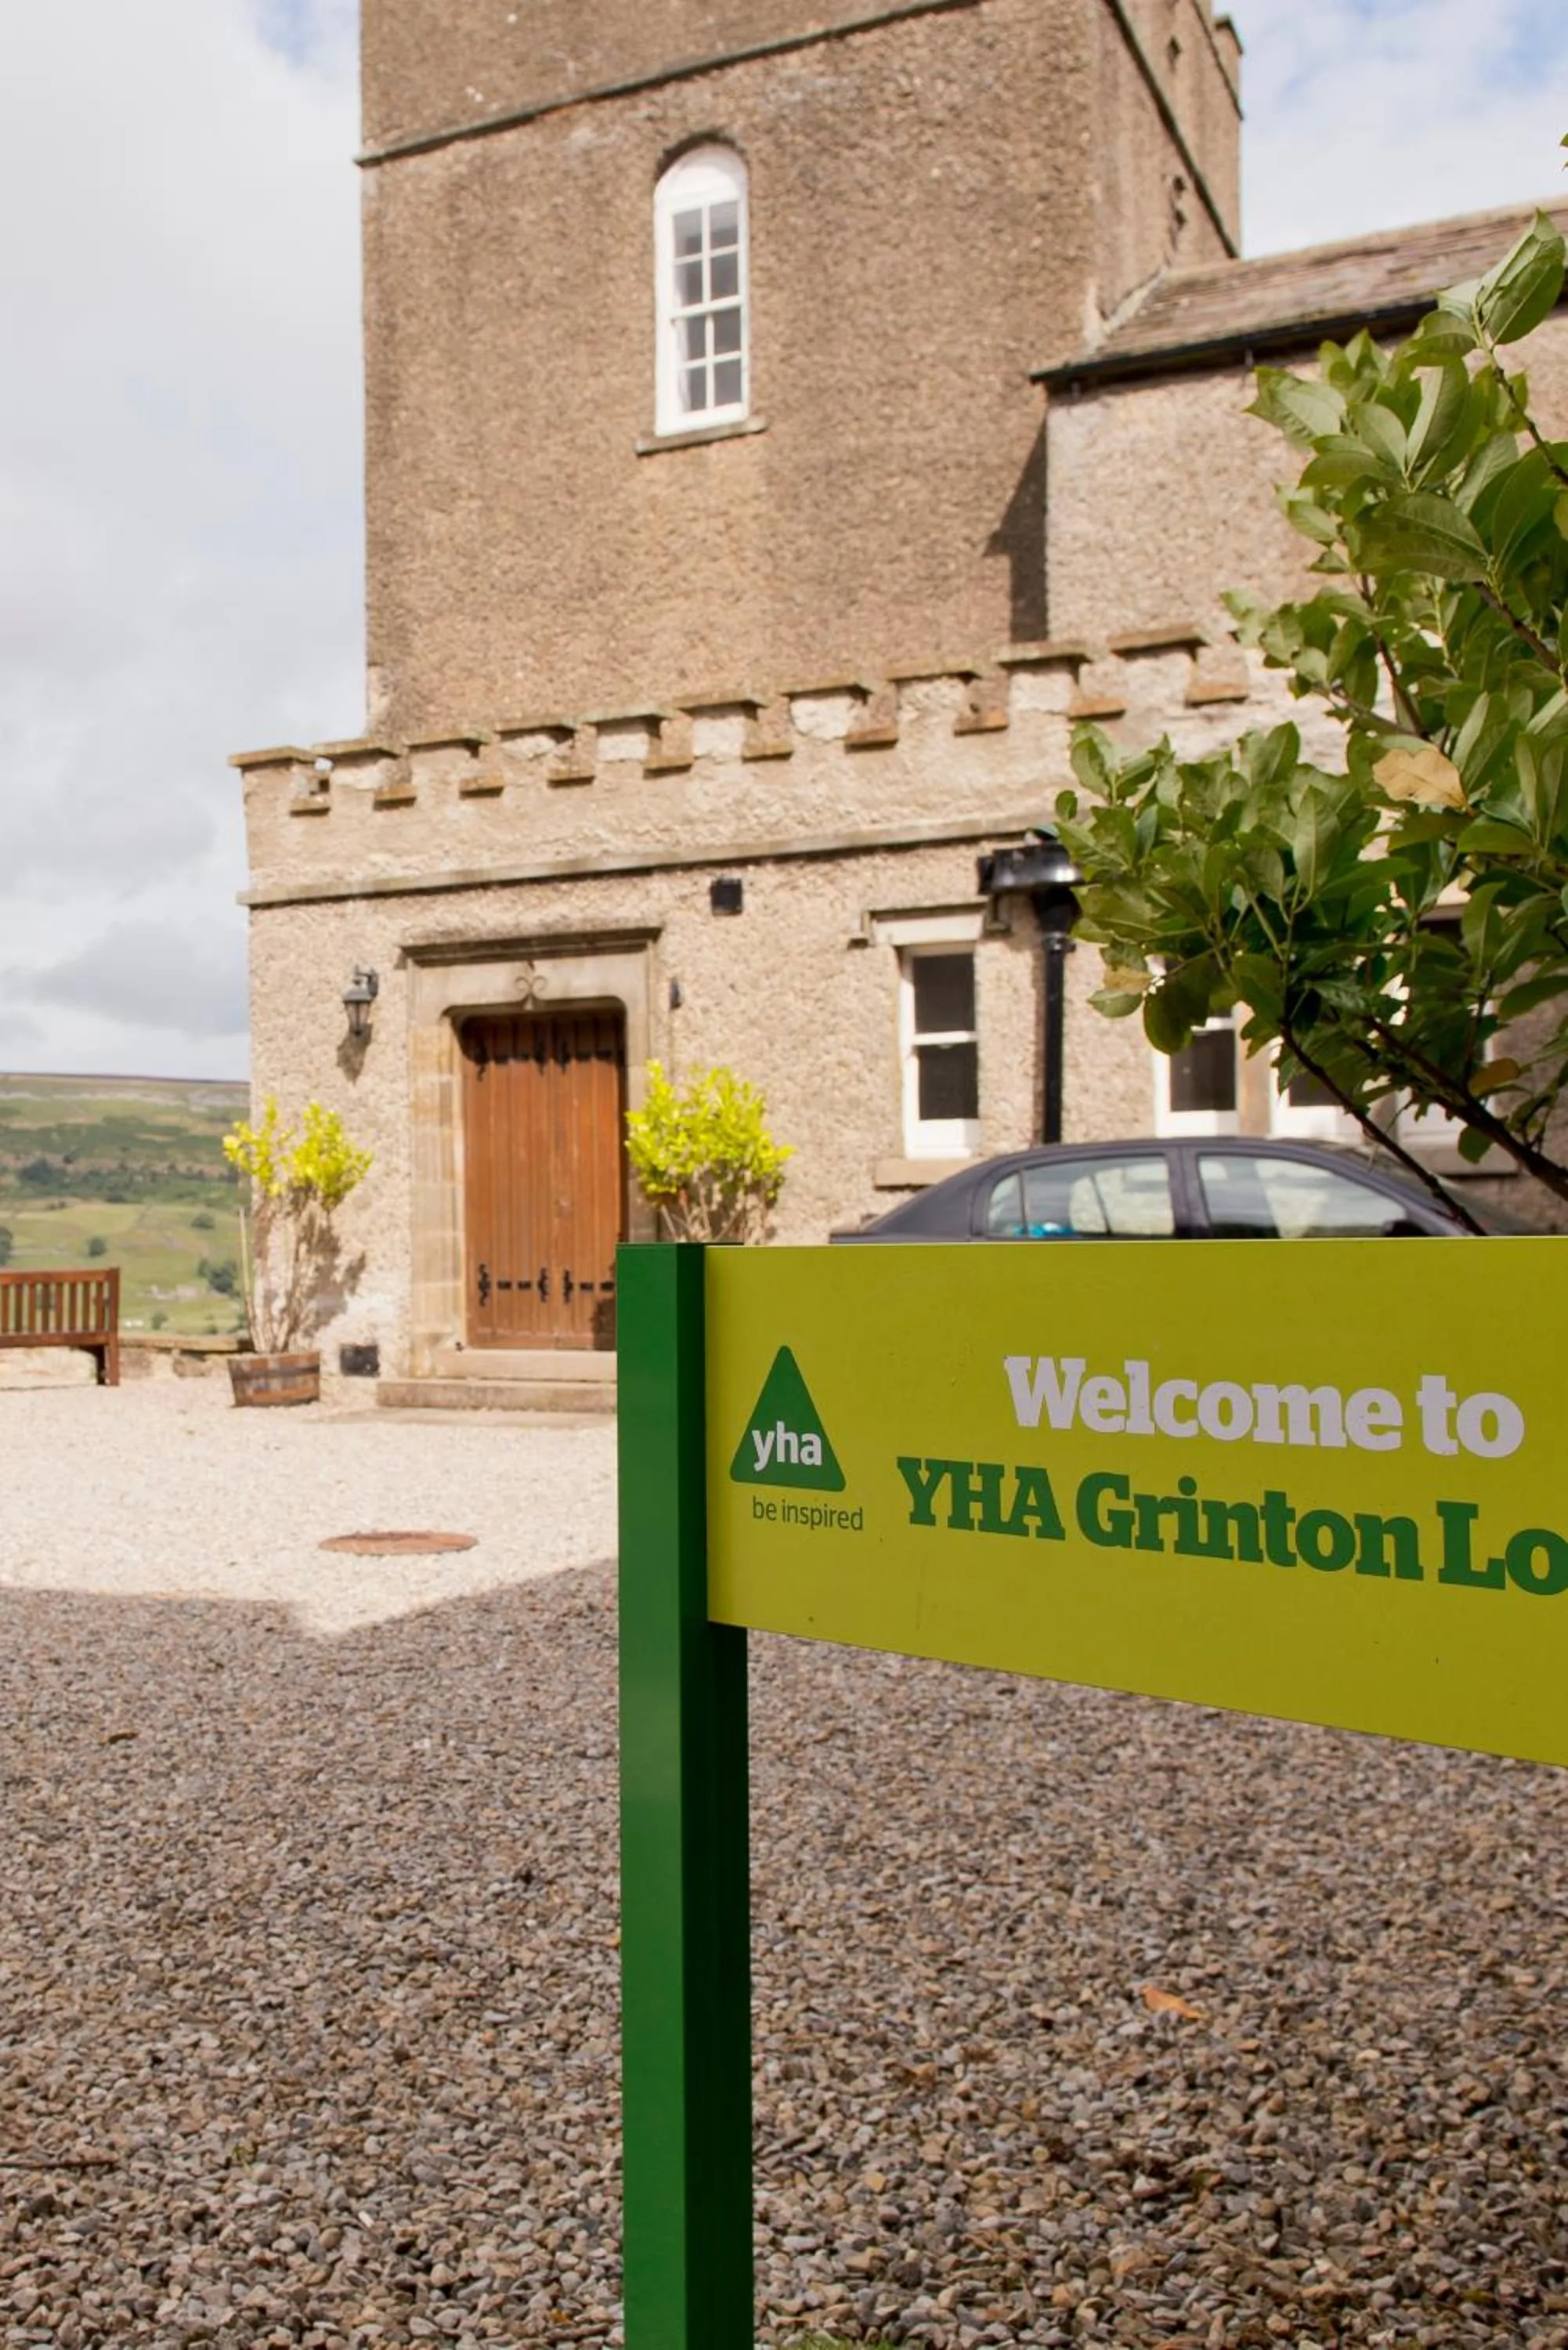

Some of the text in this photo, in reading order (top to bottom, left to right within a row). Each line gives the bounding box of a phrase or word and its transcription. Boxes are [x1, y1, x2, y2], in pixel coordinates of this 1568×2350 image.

[1003, 1356, 1525, 1458] Welcome to
[752, 1421, 823, 1471] yha
[752, 1495, 863, 1531] be inspired
[897, 1455, 1066, 1541] YHA
[1075, 1472, 1424, 1581] Grinton
